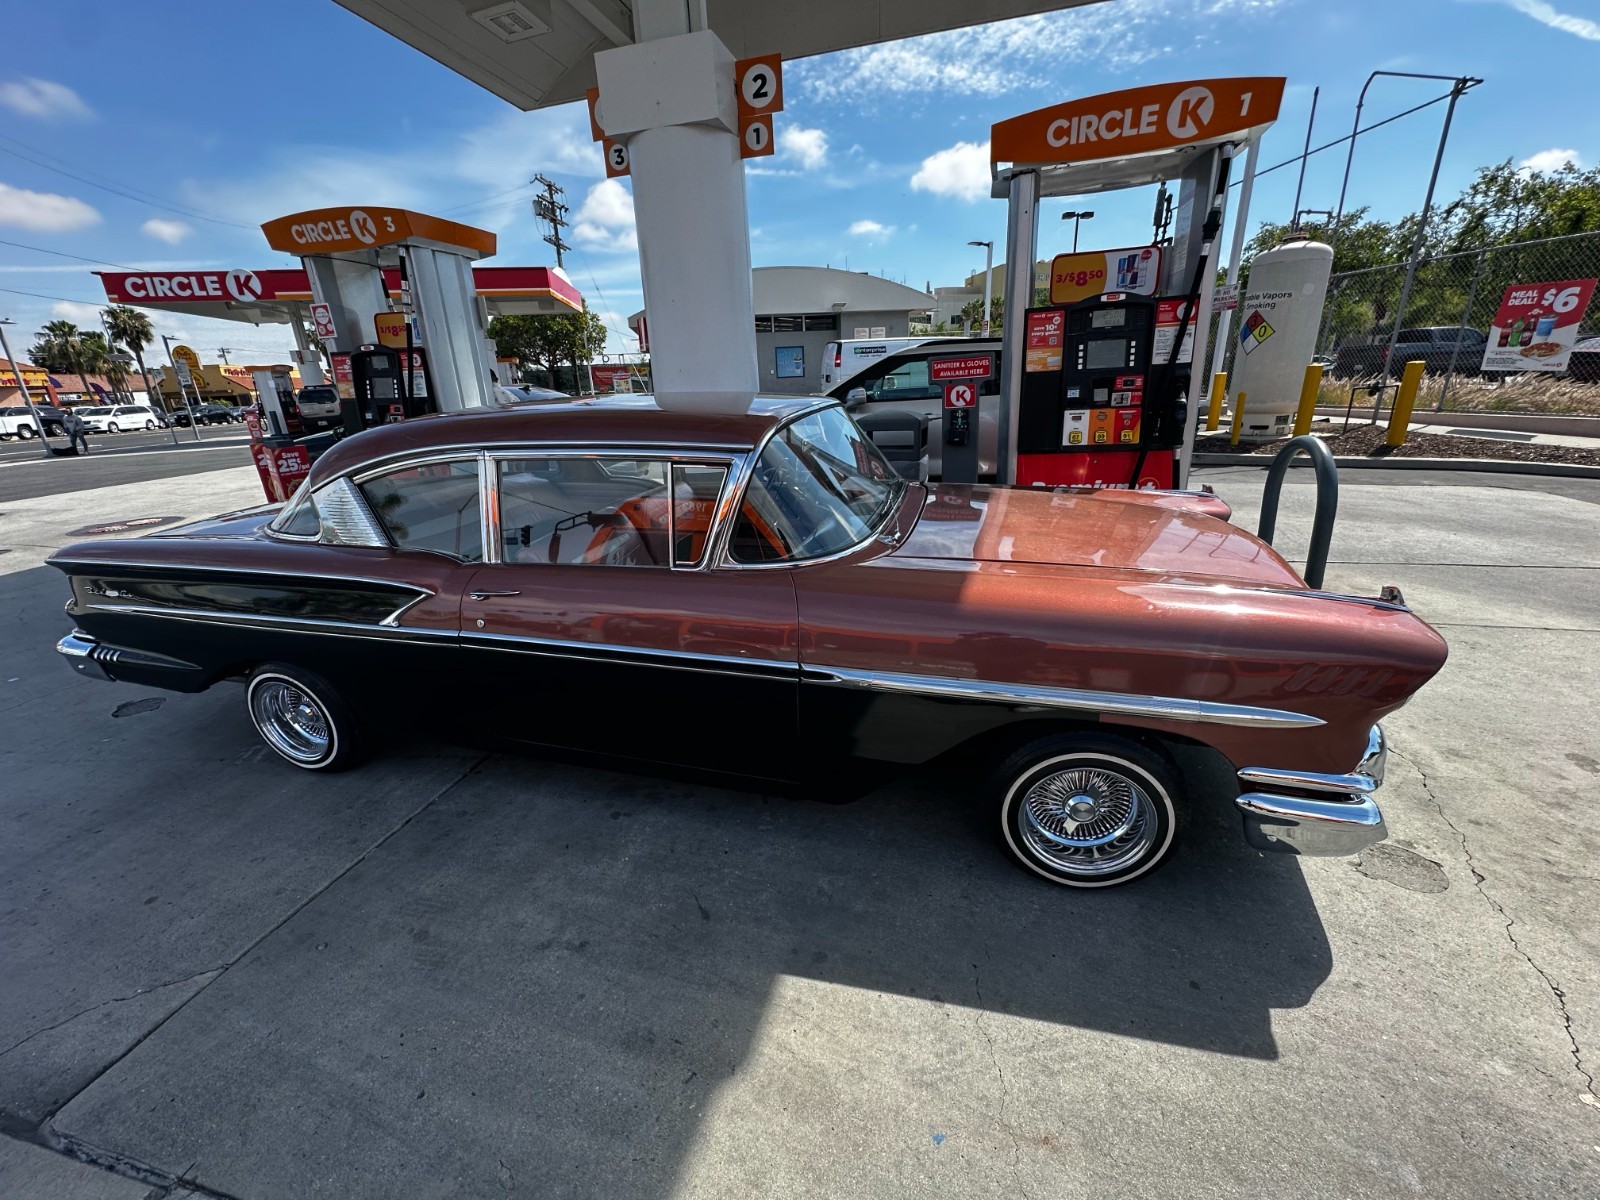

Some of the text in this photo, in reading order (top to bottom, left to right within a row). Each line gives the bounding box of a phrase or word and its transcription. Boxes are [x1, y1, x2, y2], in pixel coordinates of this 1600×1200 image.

[752, 73, 768, 100] 2
[1047, 90, 1252, 148] CIRCLE K 1
[752, 127, 761, 145] 1
[613, 148, 625, 166] 3
[291, 213, 396, 244] CIRCLE K 3
[124, 271, 262, 301] CIRCLE K
[1510, 290, 1539, 299] MEAL
[1262, 292, 1293, 300] Vapors
[1507, 298, 1538, 306] DEAL!
[1541, 286, 1582, 313] $6
[1246, 302, 1276, 310] Smoking
[1258, 325, 1267, 338] 0
[933, 361, 960, 370] SANITIZER
[966, 359, 990, 367] GLOVES
[953, 387, 970, 406] K
